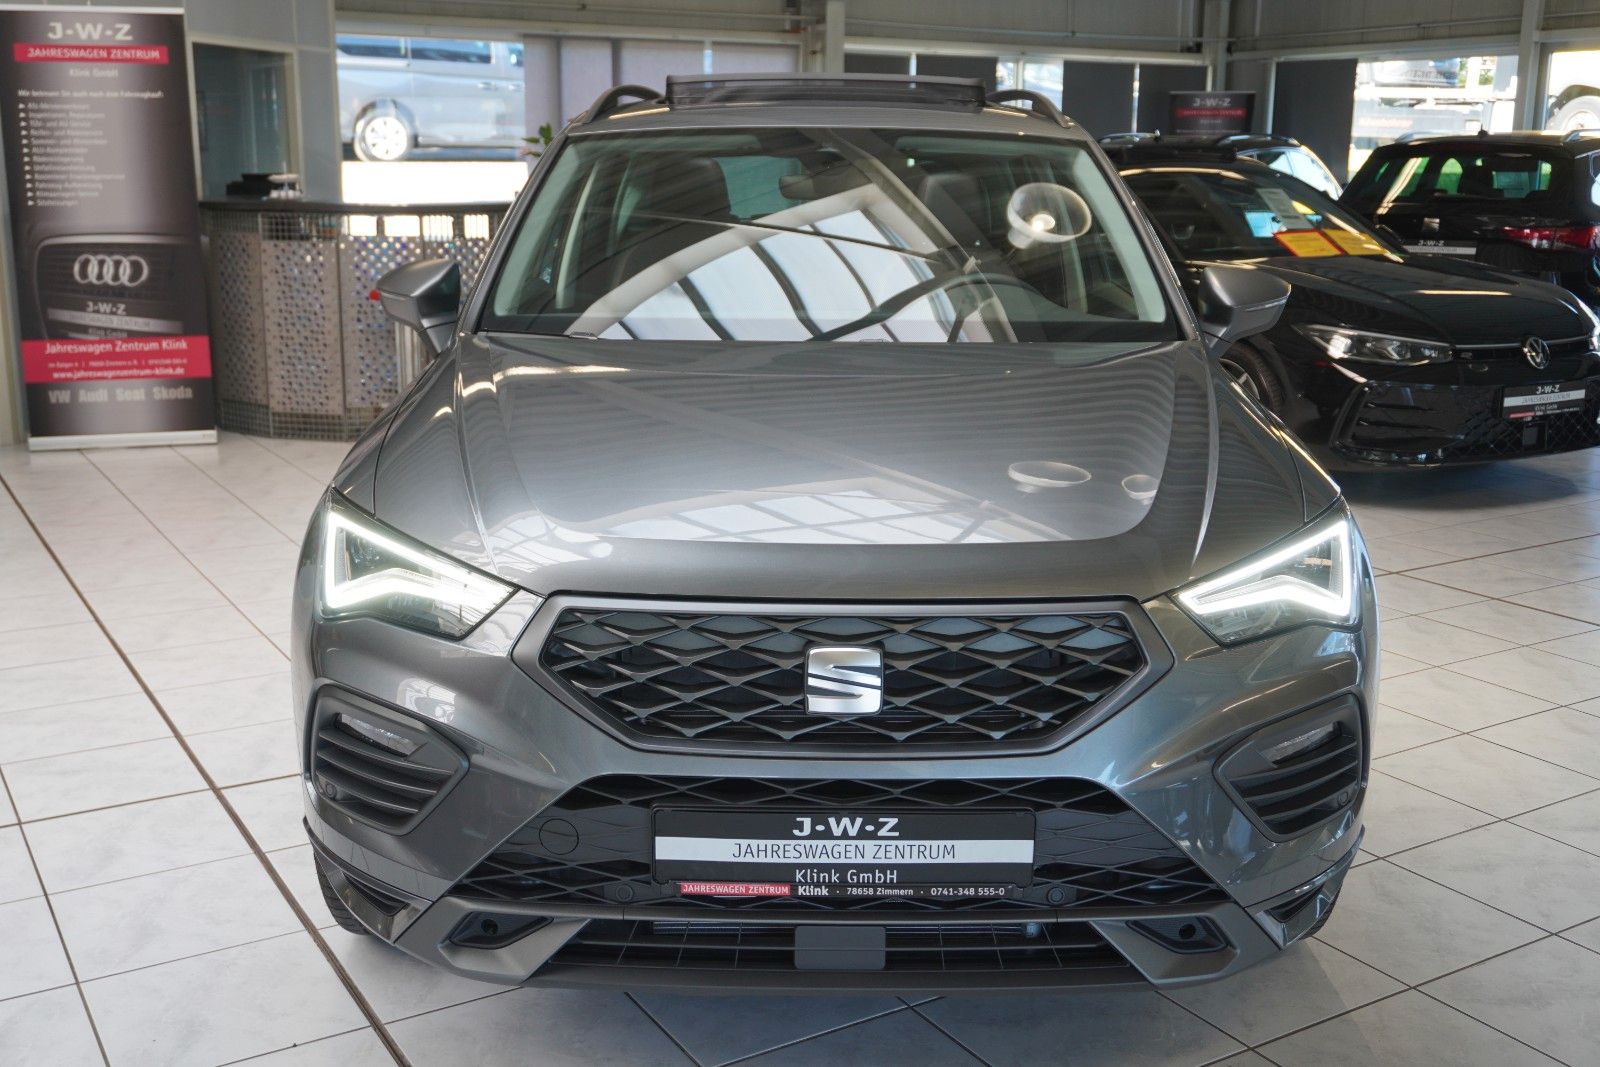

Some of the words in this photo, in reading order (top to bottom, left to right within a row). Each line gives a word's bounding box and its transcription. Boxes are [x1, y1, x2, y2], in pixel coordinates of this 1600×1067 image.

[27, 47, 108, 58] JAHRESWAGEN
[110, 48, 160, 60] ZENTRUM
[45, 341, 113, 355] Jahreswagen
[115, 340, 160, 352] Zentrum
[162, 339, 188, 351] Klink
[48, 390, 71, 404] VW
[79, 389, 108, 403] Audi
[115, 387, 145, 401] Seat
[153, 385, 193, 400] Skoda
[731, 842, 866, 860] JAHRESWAGEN
[872, 843, 957, 860] ZENTRUM
[795, 869, 840, 884] Klink
[847, 869, 898, 884] GmbH
[681, 883, 746, 895] JAHRESWAGEN
[747, 885, 789, 895] ZENTRUM
[797, 885, 829, 896] Klink
[846, 887, 873, 896] 78658
[876, 887, 914, 896] Zimmern
[930, 887, 975, 896] 0741-348
[978, 887, 1005, 896] 555-0
